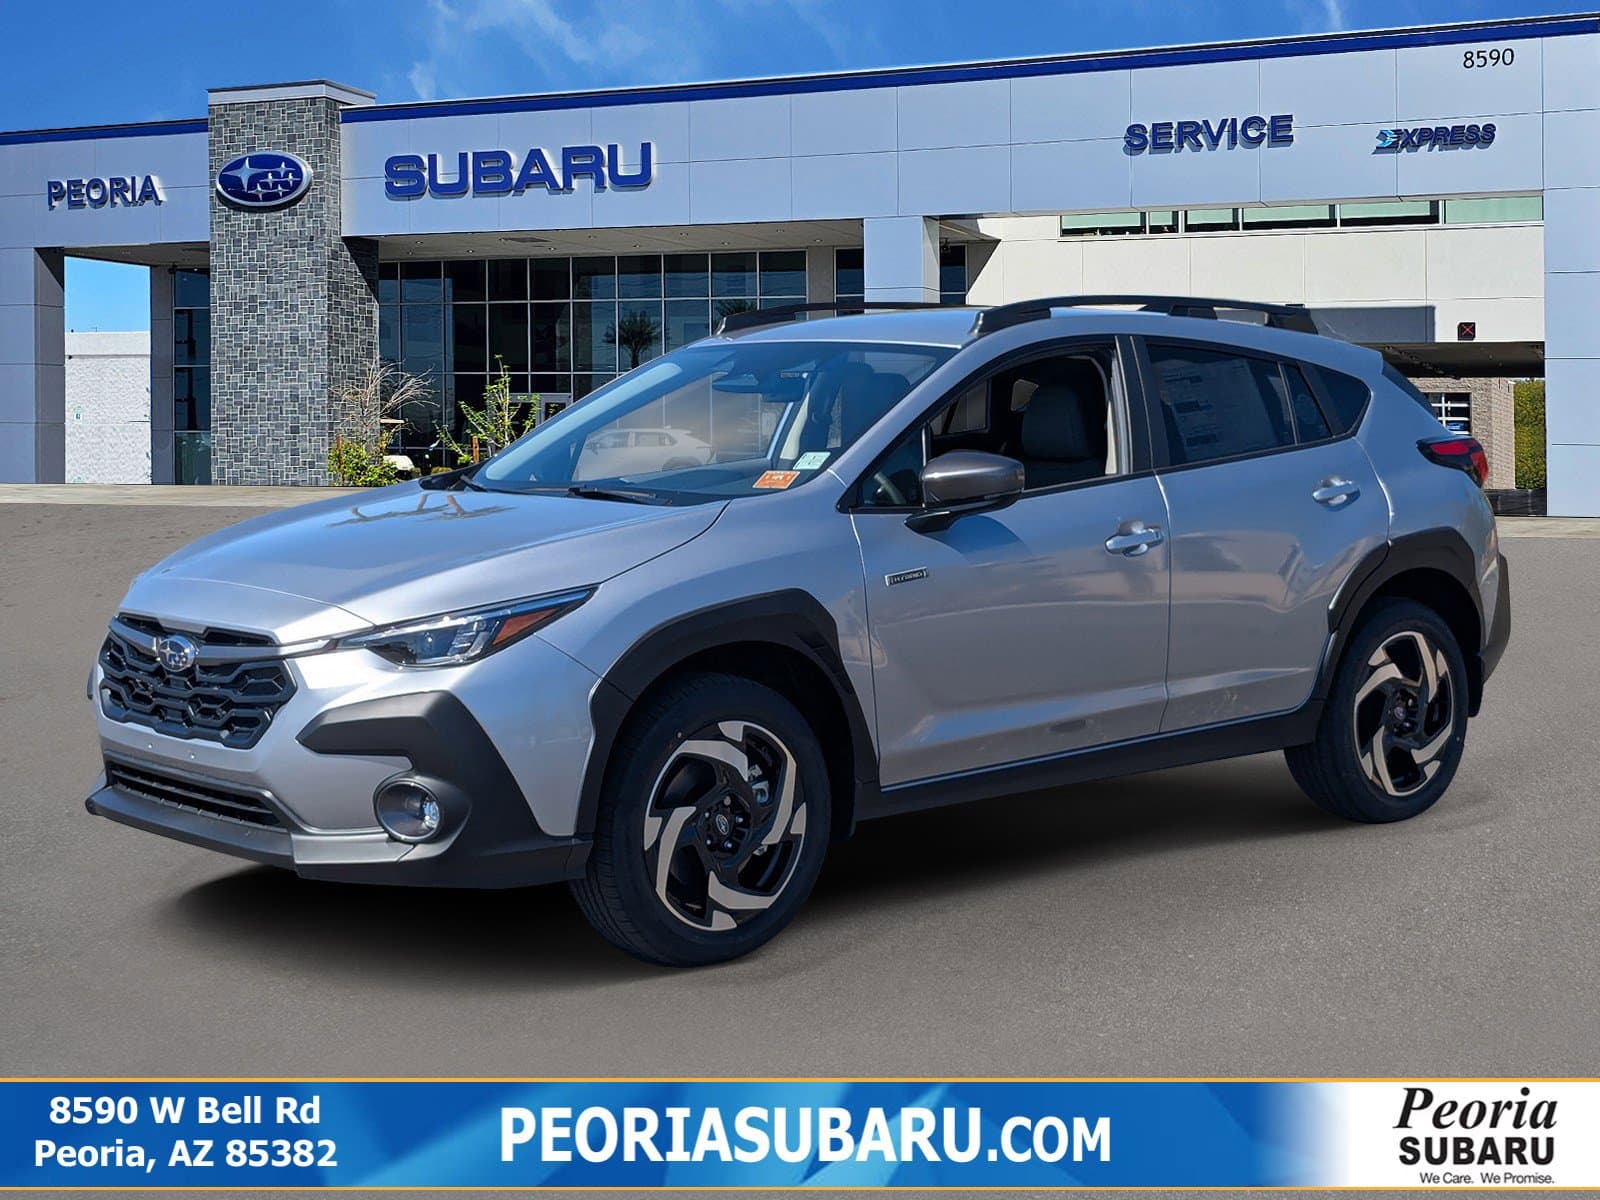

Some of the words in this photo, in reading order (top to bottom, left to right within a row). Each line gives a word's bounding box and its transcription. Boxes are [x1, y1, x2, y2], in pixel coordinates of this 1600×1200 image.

[1462, 48, 1515, 69] 8590
[1124, 114, 1294, 154] SERVICE
[1375, 122, 1497, 150] EXPRESS
[384, 141, 653, 199] SUBARU
[47, 174, 164, 209] PEORIA
